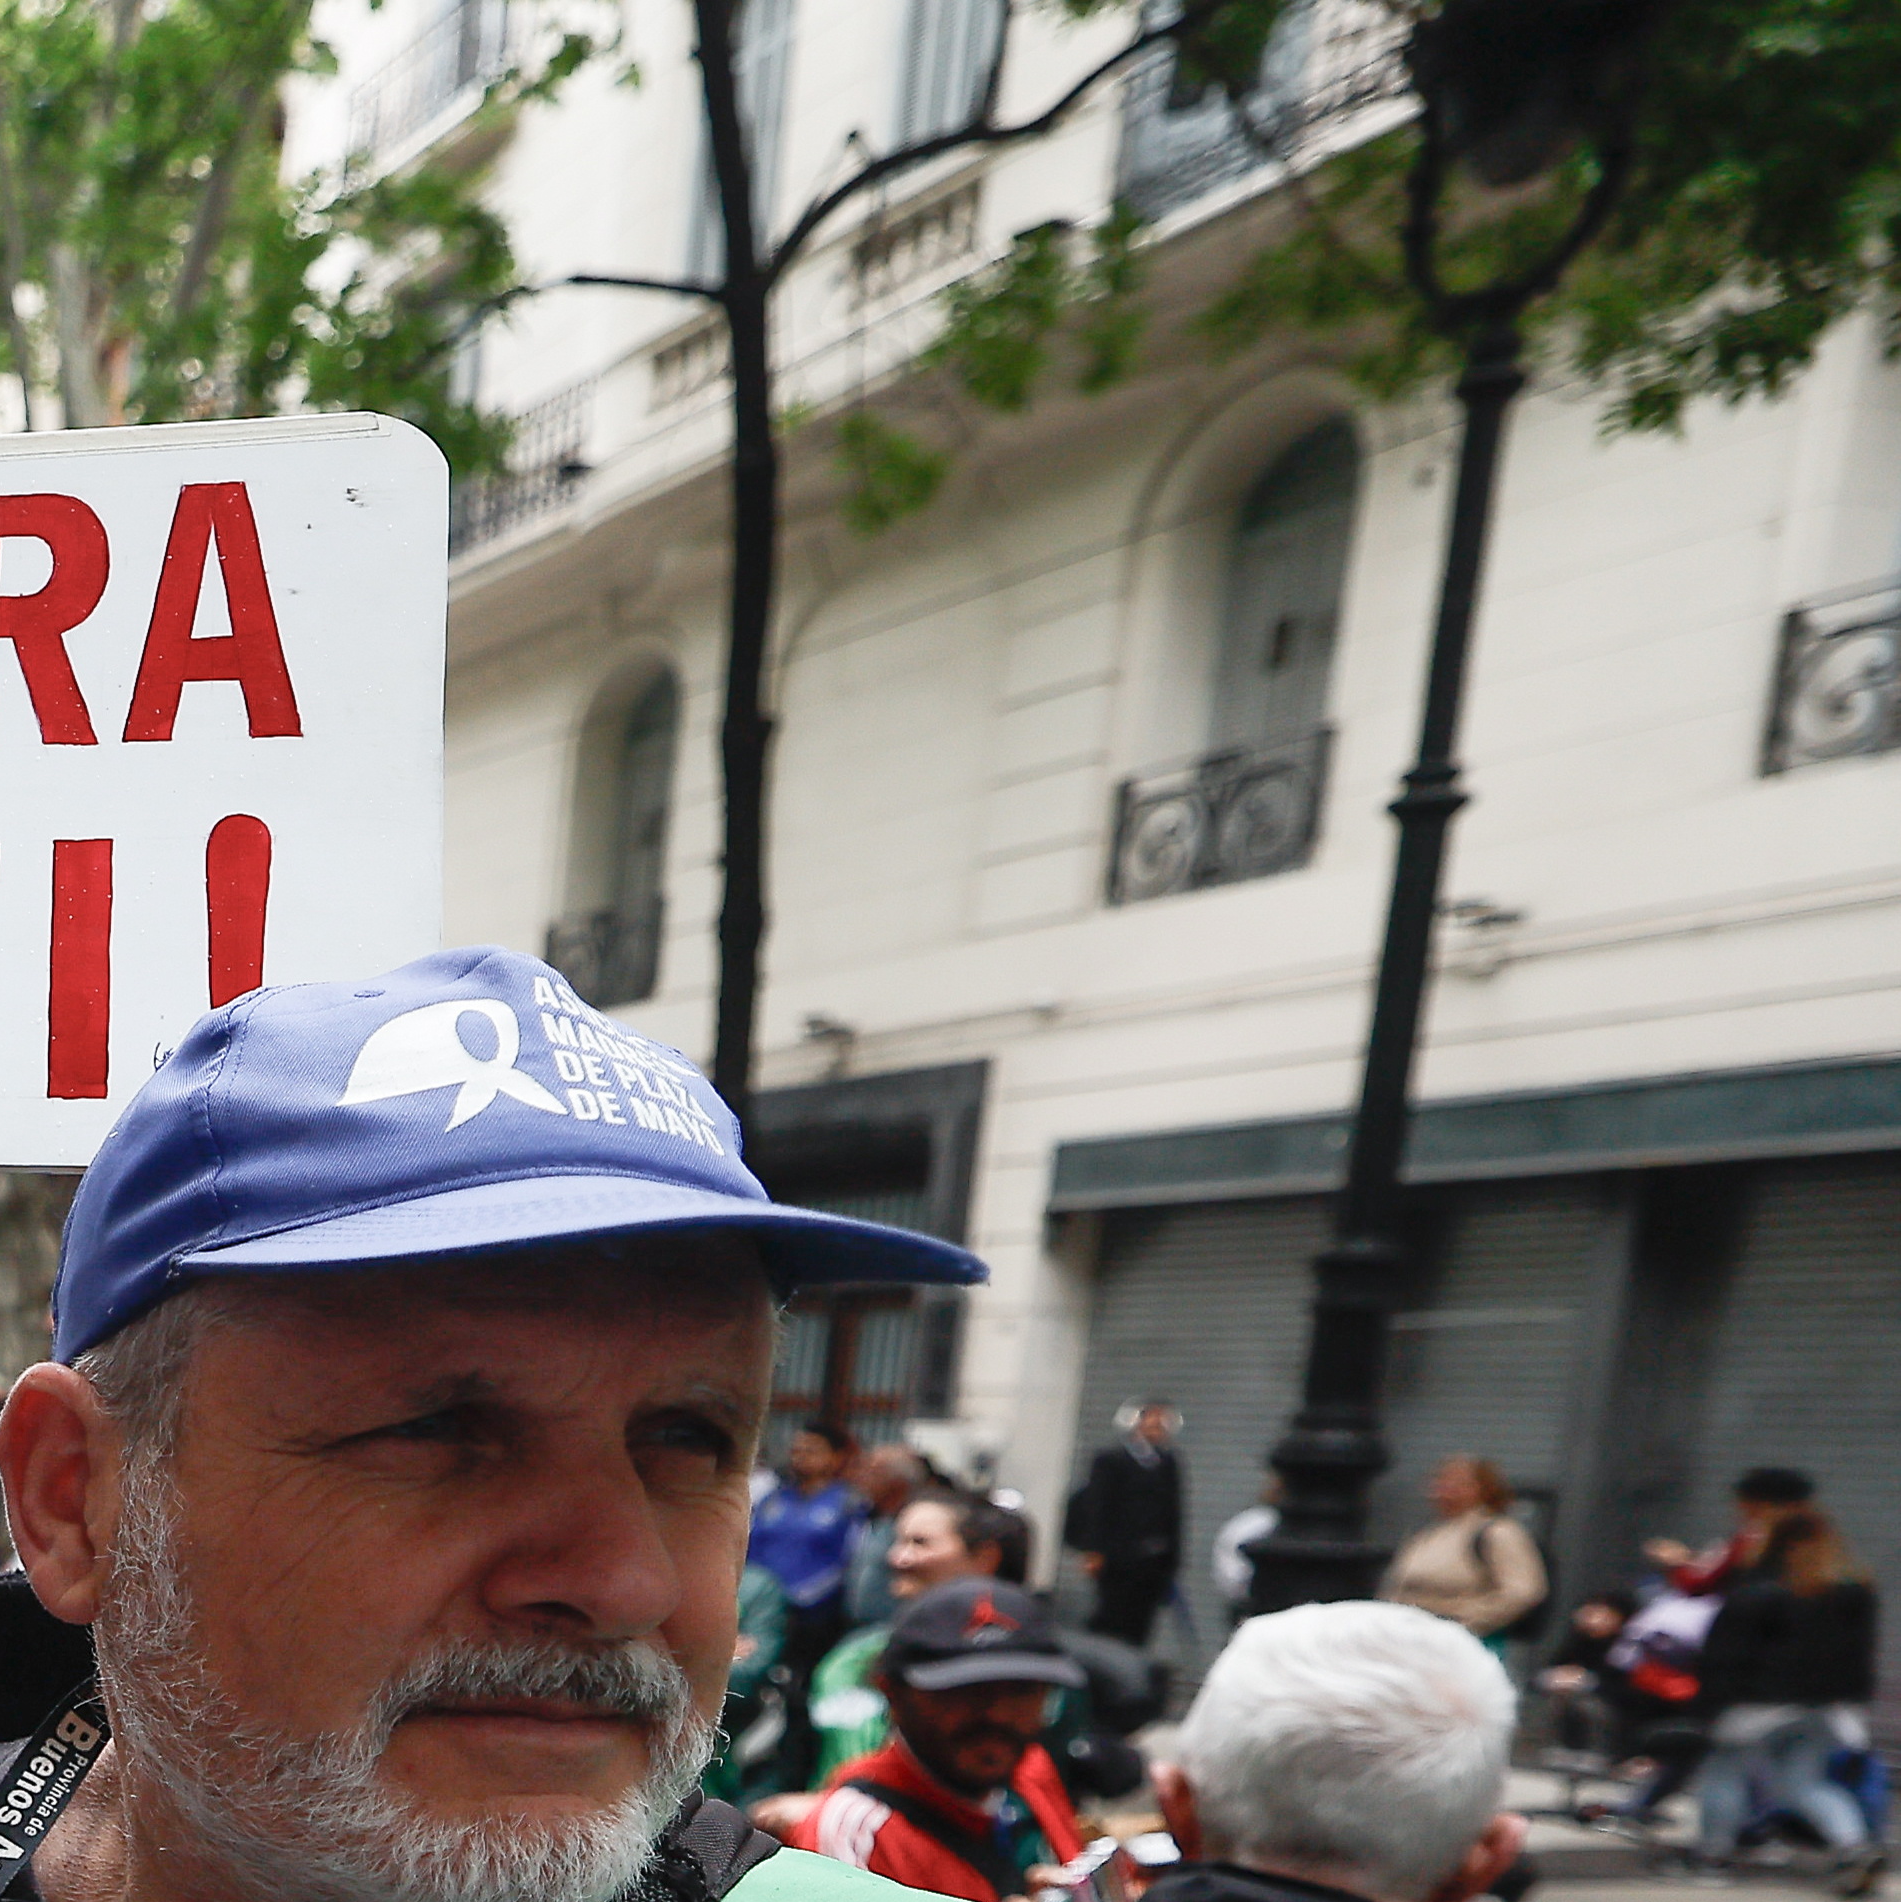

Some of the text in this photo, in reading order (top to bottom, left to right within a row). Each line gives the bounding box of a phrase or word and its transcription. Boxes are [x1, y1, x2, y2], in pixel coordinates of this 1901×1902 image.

[553, 1050, 716, 1126] DE PLAZA
[564, 1086, 726, 1156] DE MAYO
[24, 1752, 89, 1837] Provincia de
